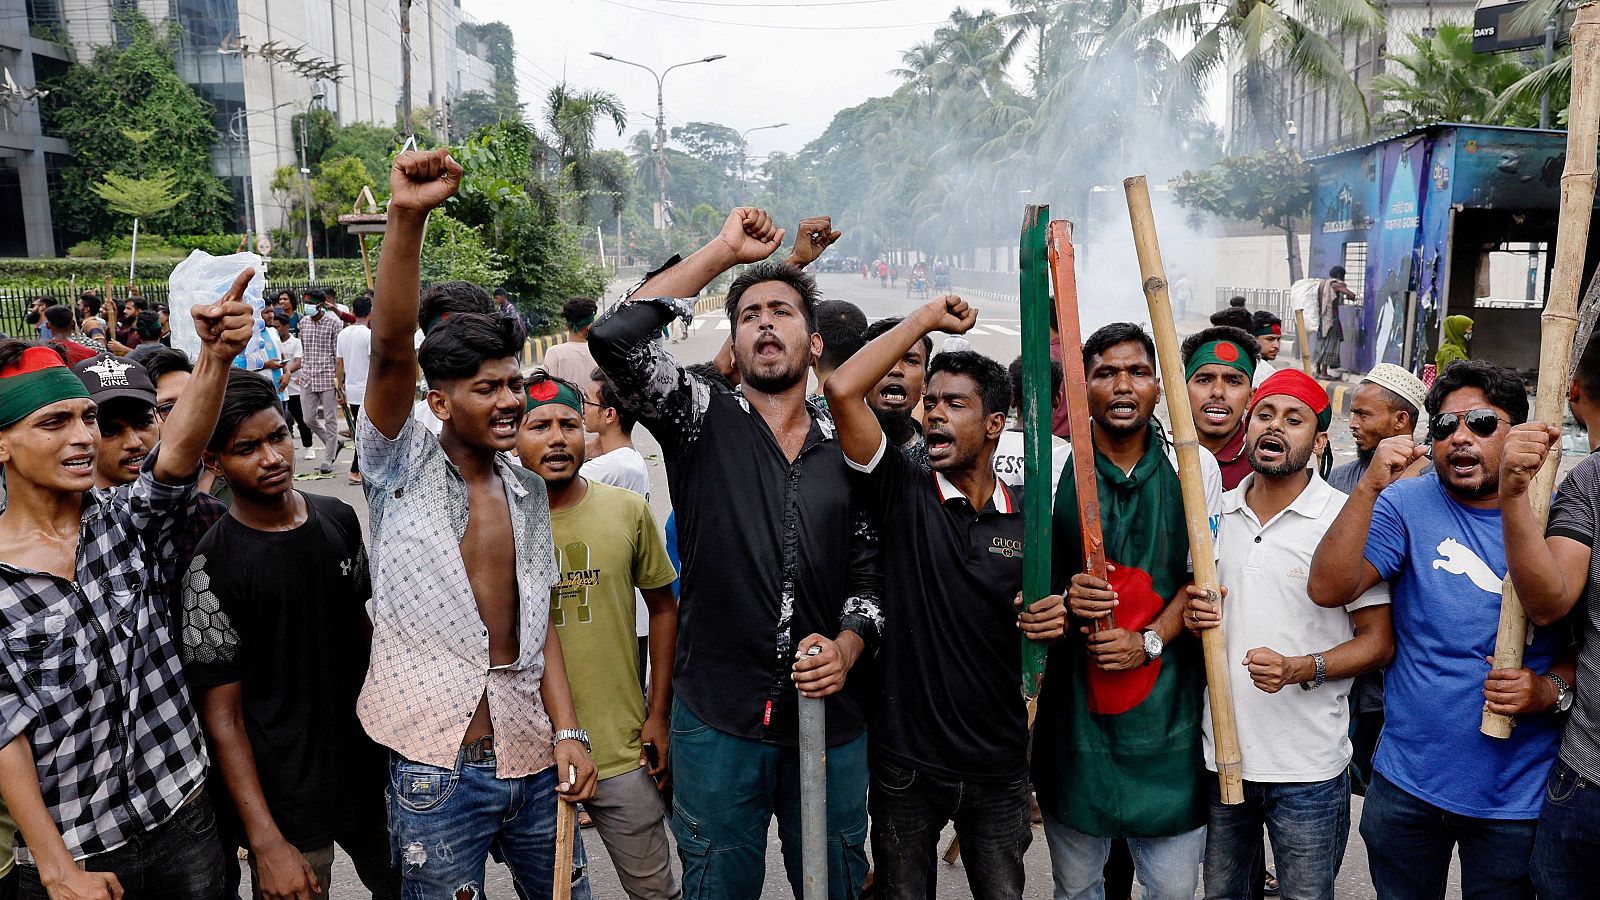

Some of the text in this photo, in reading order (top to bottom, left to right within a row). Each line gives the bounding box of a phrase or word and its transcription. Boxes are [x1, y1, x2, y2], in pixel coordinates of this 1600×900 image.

[1474, 27, 1495, 37] DAYS
[1404, 202, 1414, 213] ON
[1402, 216, 1420, 228] GONE
[100, 379, 129, 388] KING
[993, 455, 1024, 474] ESS
[992, 536, 1022, 551] GUCCI
